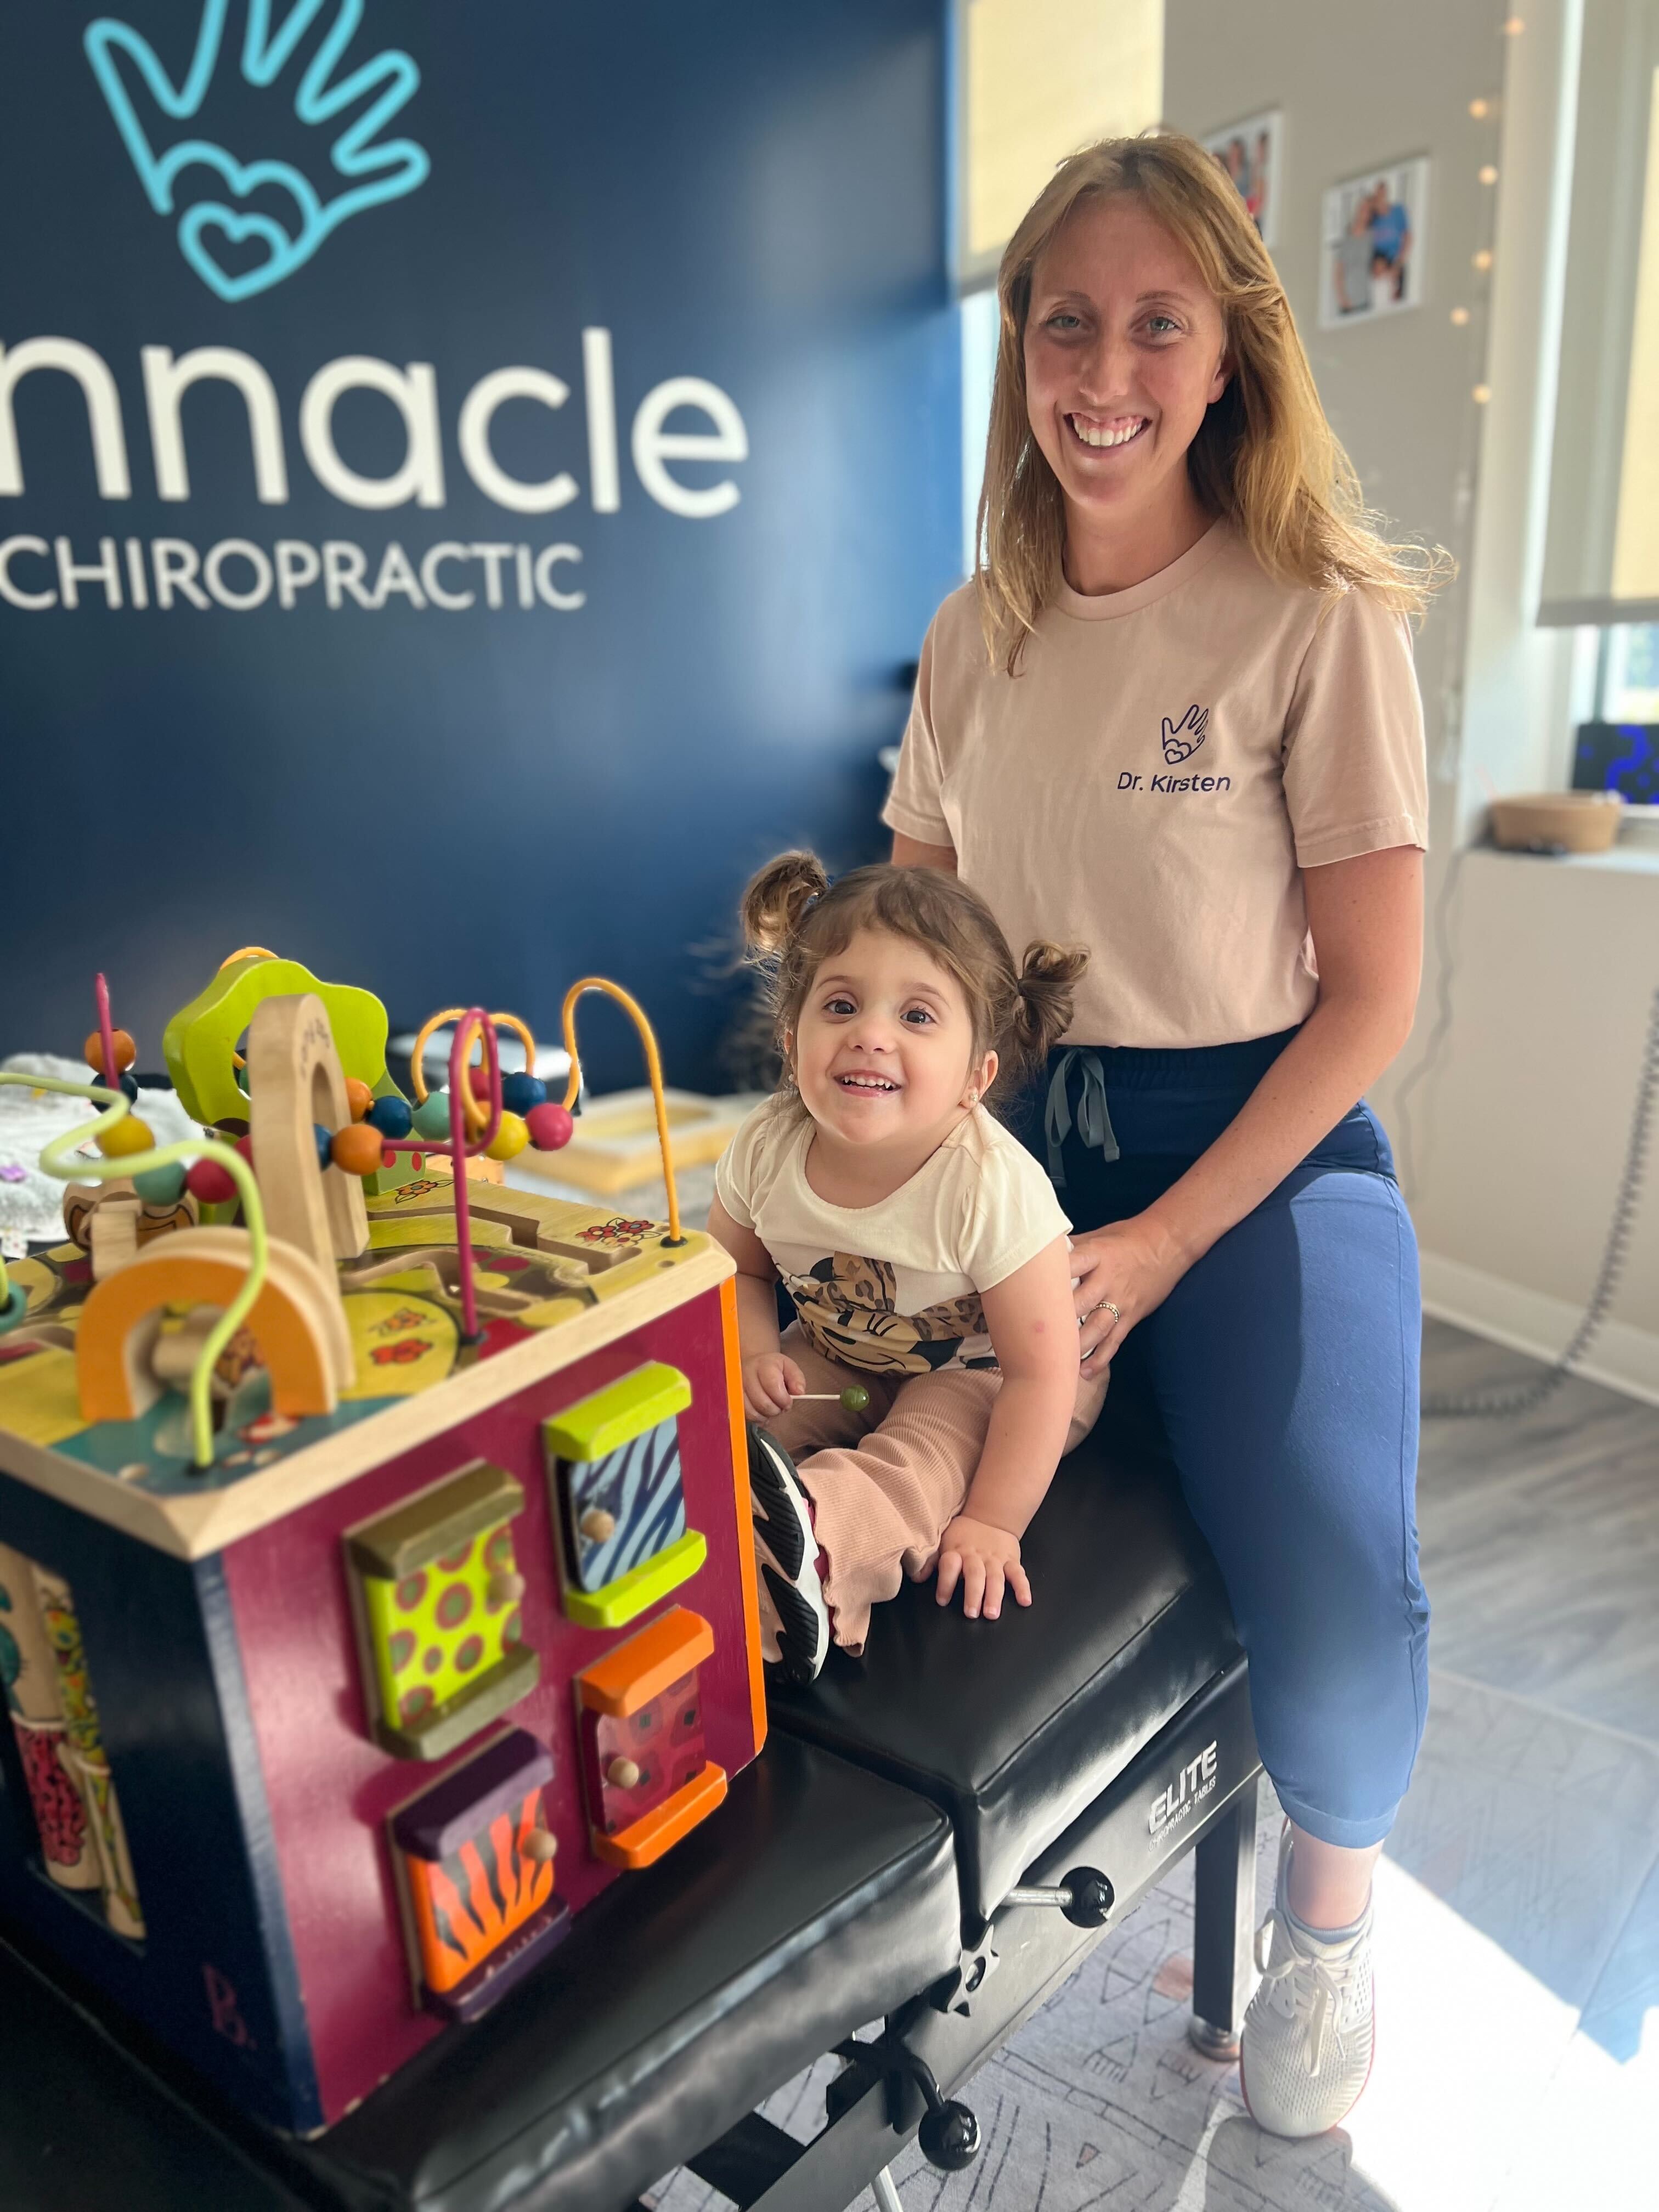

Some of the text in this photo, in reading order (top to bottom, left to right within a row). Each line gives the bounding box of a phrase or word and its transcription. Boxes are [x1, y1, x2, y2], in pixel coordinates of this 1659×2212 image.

[0, 326, 749, 519] nnacle
[0, 534, 586, 611] CHIROPRACTIC
[1117, 772, 1231, 793] Dr. Kirsten
[1149, 1740, 1217, 1835] ELITE
[1194, 1775, 1216, 1805] TABLES
